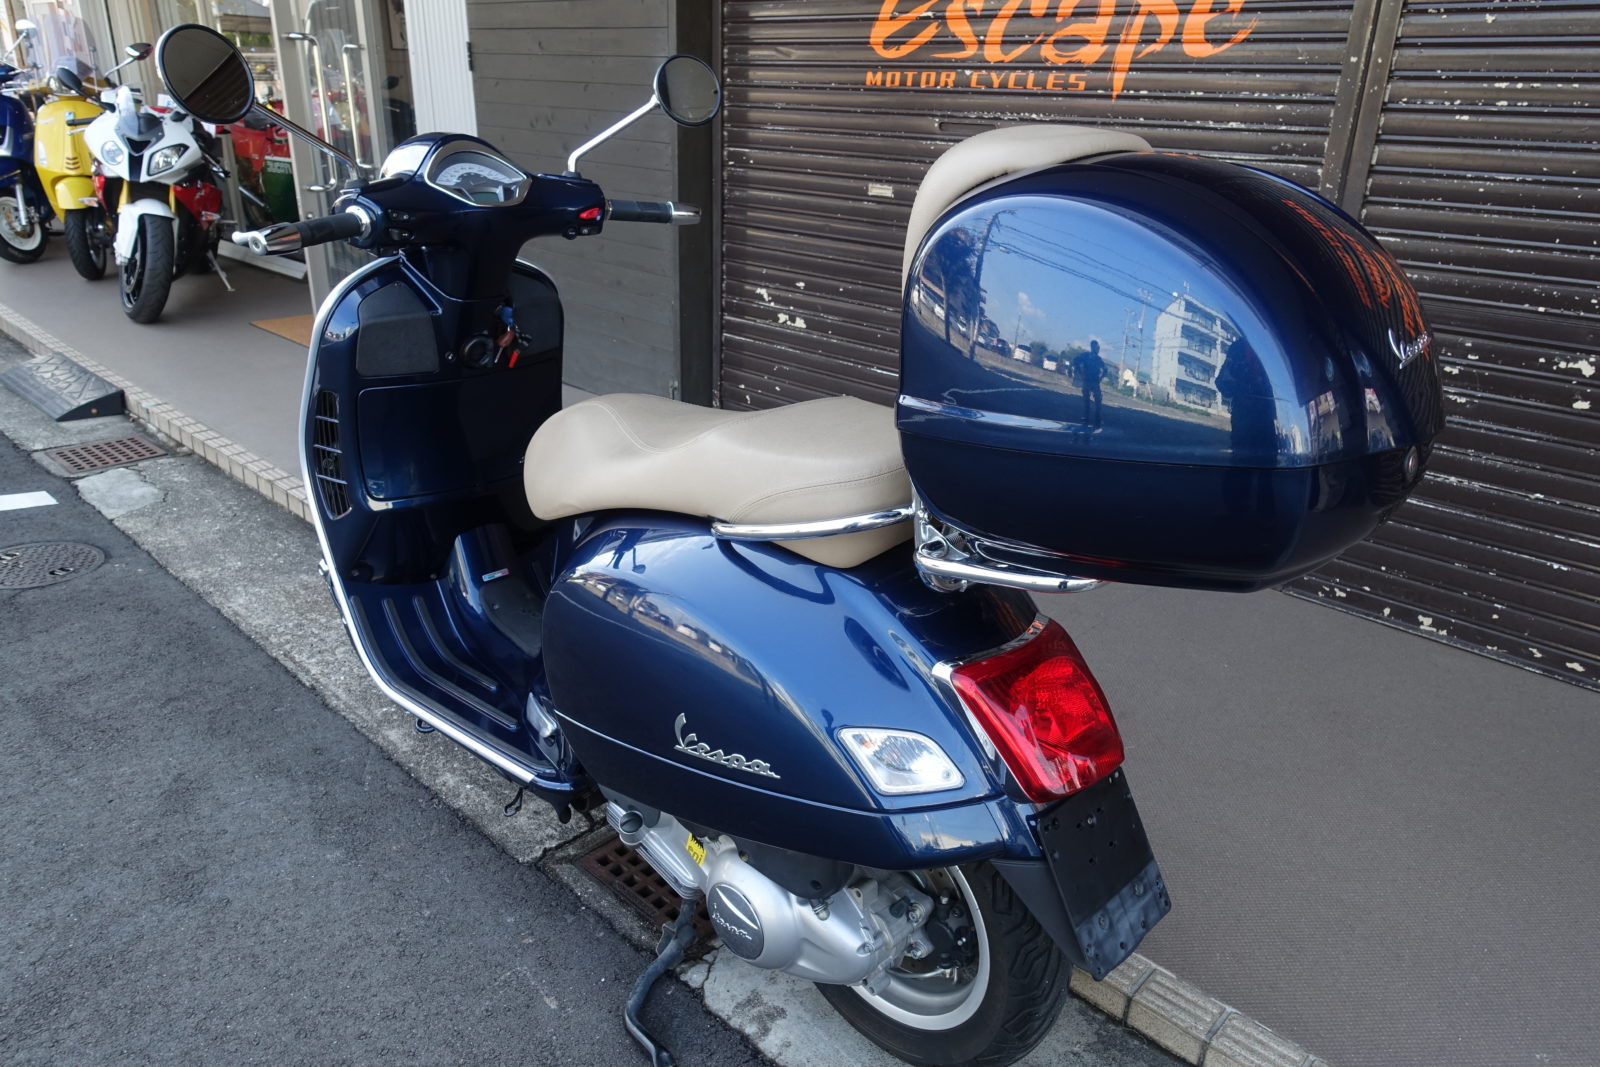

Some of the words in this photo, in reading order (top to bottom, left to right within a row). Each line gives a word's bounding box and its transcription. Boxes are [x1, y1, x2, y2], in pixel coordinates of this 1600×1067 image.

[865, 71, 956, 88] MOTOR
[970, 71, 1088, 91] CYCLES
[867, 0, 1257, 102] escape
[674, 712, 781, 779] Vespa
